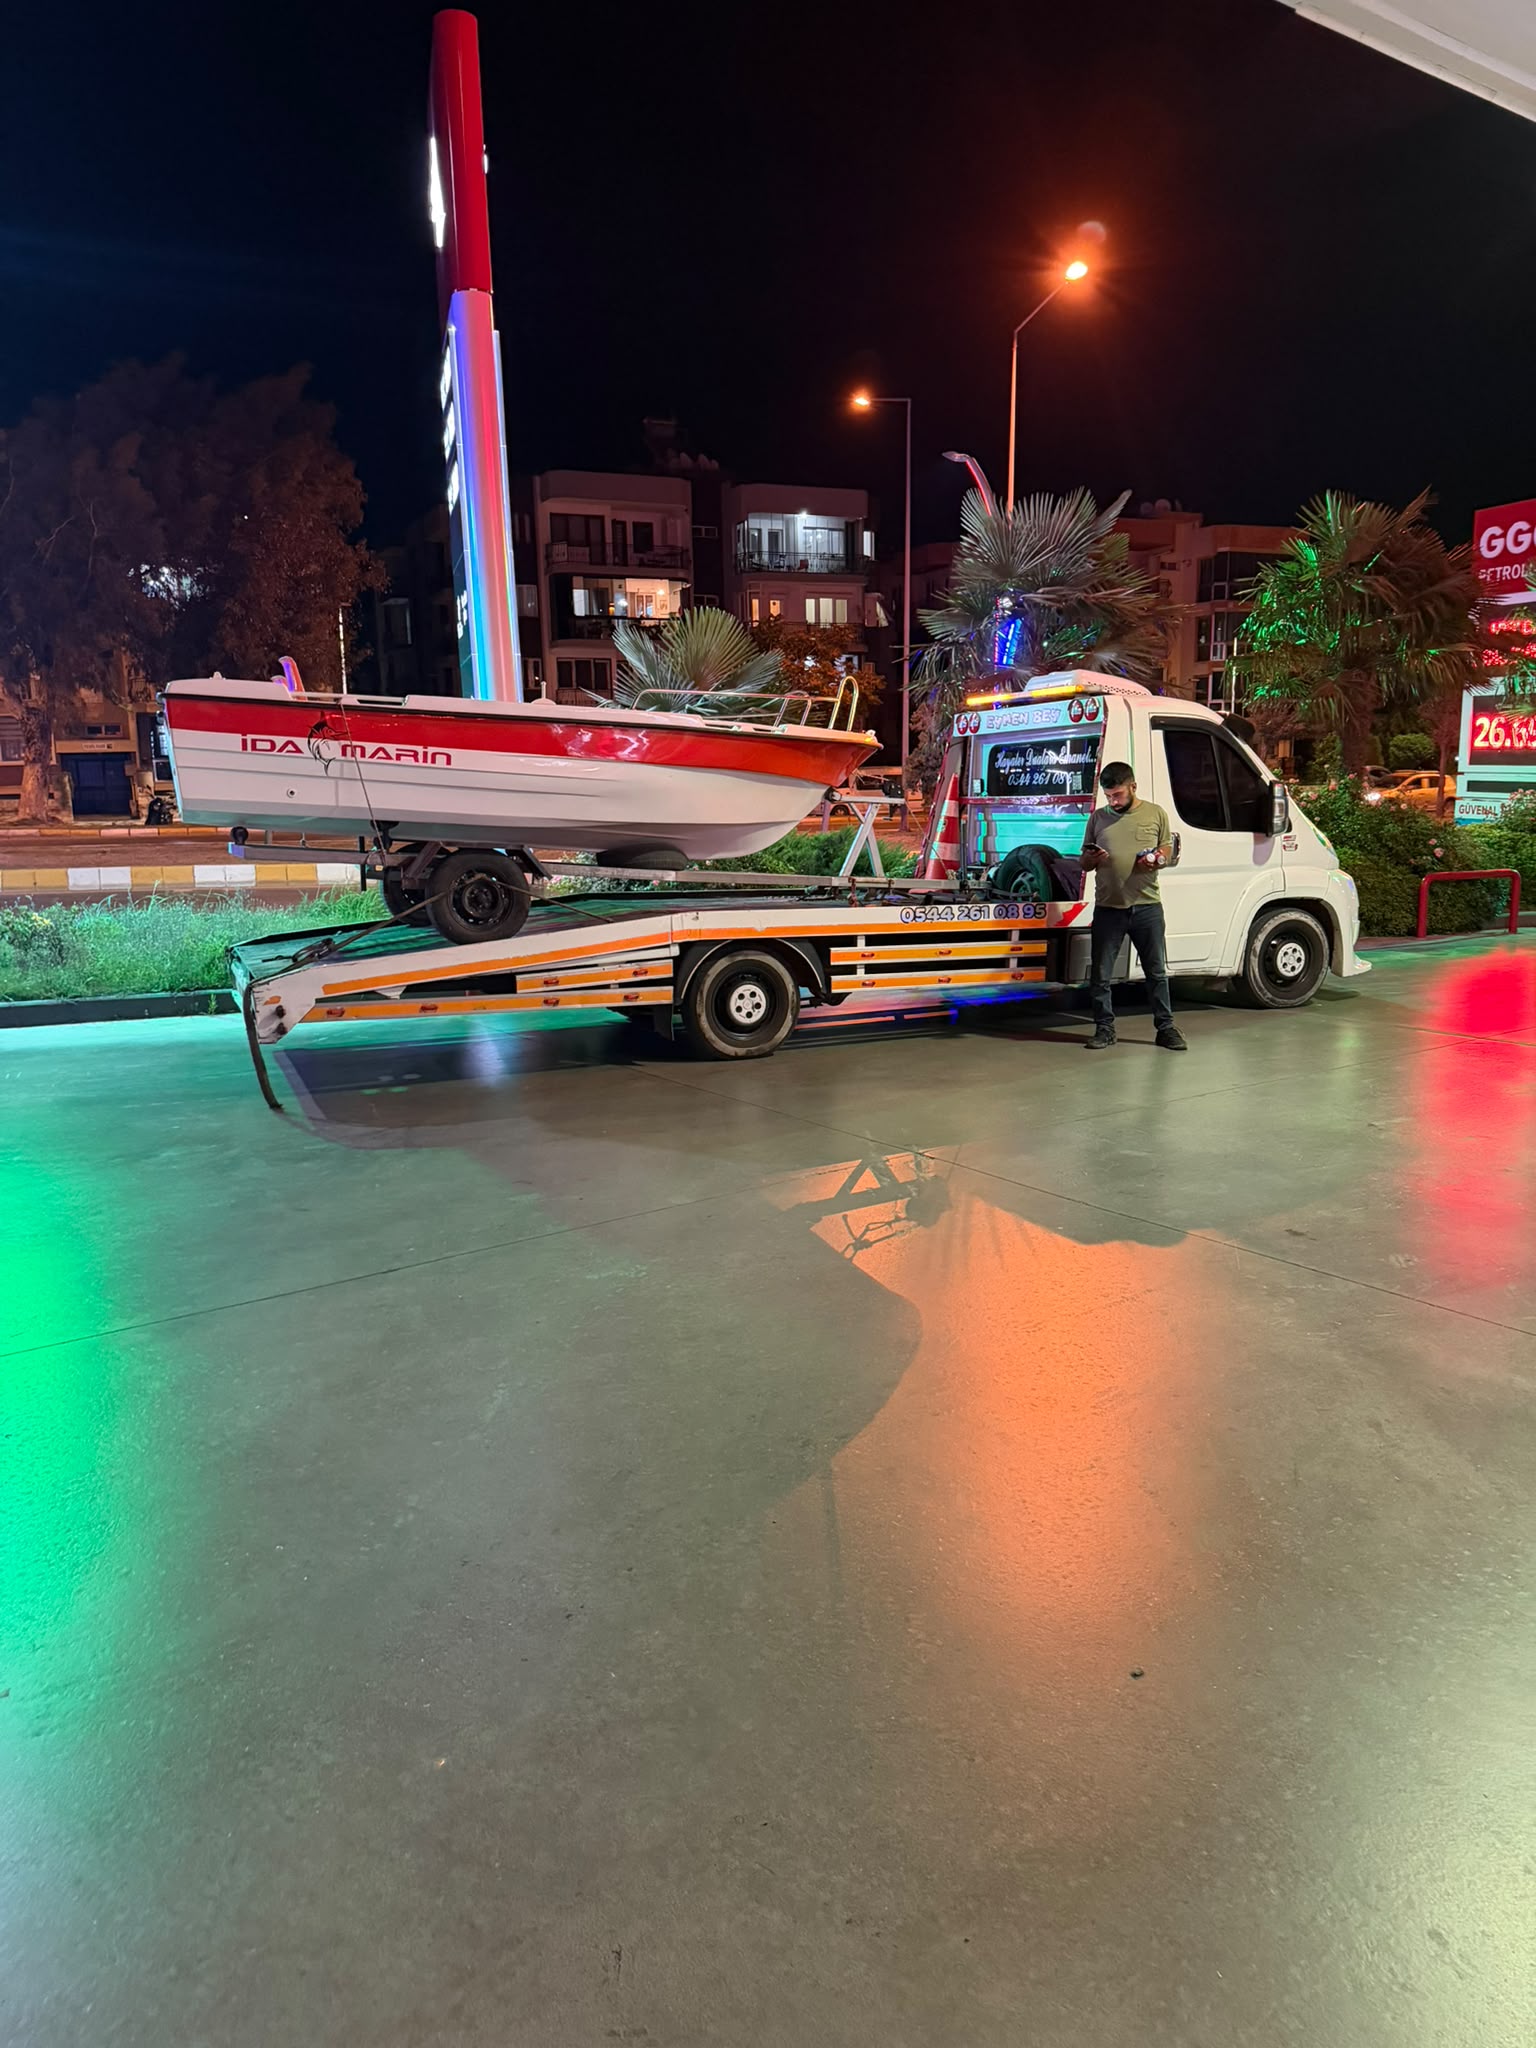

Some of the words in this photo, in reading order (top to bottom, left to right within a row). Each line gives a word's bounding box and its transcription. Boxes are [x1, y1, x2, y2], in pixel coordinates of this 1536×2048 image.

[1480, 520, 1536, 559] GG
[986, 711, 1029, 729] EYMEN
[1033, 708, 1061, 724] BEY
[1032, 772, 1051, 784] 261
[900, 907, 954, 923] 0544
[957, 905, 990, 921] 261
[993, 904, 1020, 919] 08
[1023, 903, 1047, 919] 95
